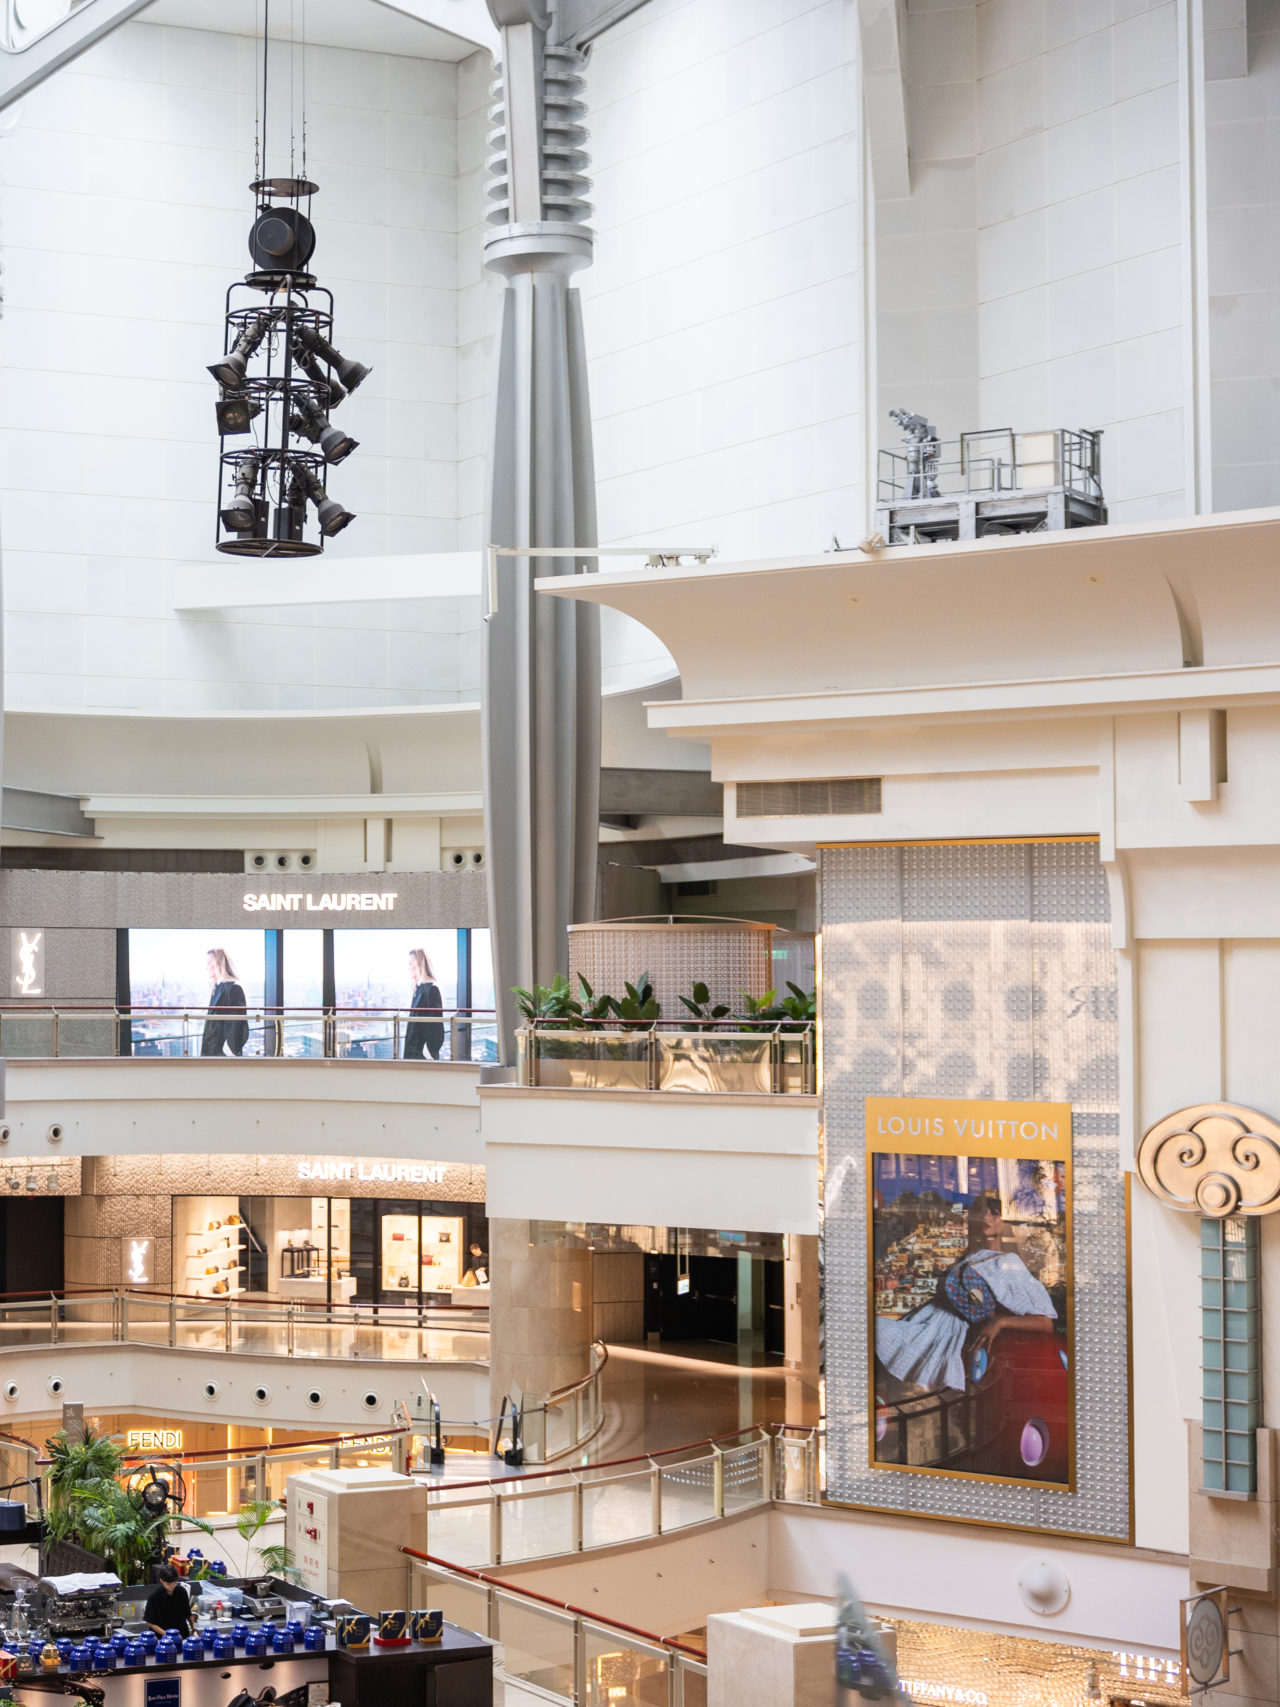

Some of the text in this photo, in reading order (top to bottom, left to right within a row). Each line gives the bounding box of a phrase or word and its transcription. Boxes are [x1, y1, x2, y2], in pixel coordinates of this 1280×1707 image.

[243, 893, 398, 911] SAINT LAURENT
[878, 1115, 1059, 1141] LOUIS VUITTON
[297, 1161, 447, 1184] SAINT LAURENT
[128, 1430, 183, 1449] FENDI
[1113, 1650, 1182, 1685] TIFF
